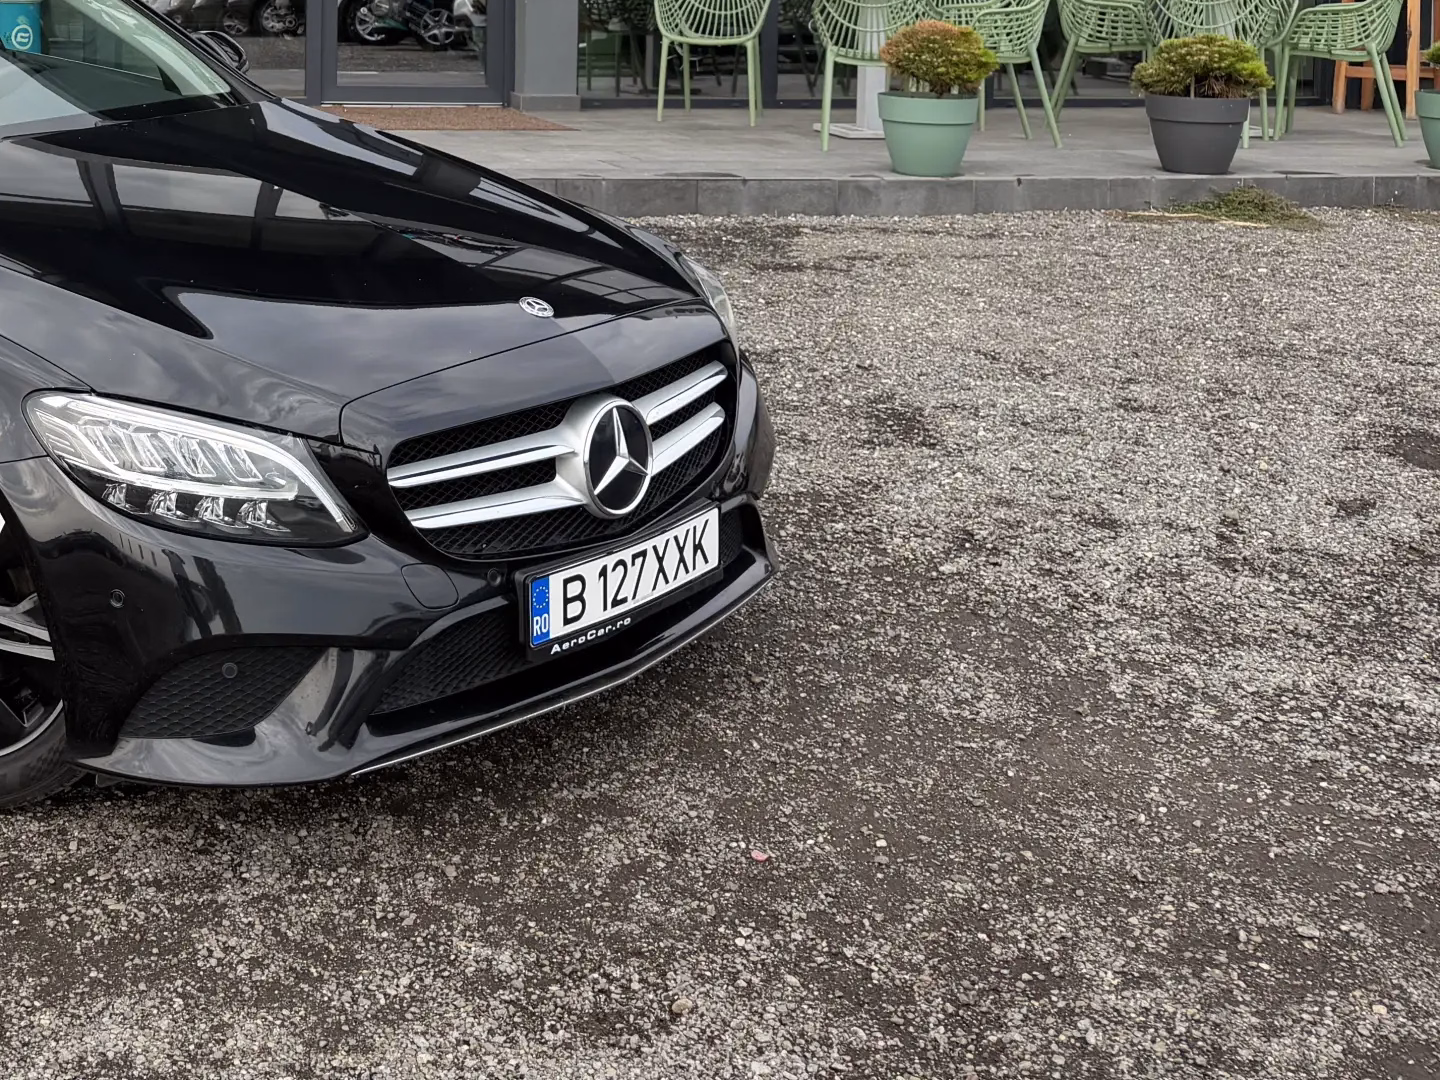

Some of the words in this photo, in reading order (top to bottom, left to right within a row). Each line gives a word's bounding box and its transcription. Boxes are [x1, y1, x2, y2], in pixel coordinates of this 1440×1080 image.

[562, 573, 587, 627] B
[597, 518, 710, 613] 127XXK
[533, 613, 549, 637] RO
[550, 617, 632, 655] AeroCar.ro
